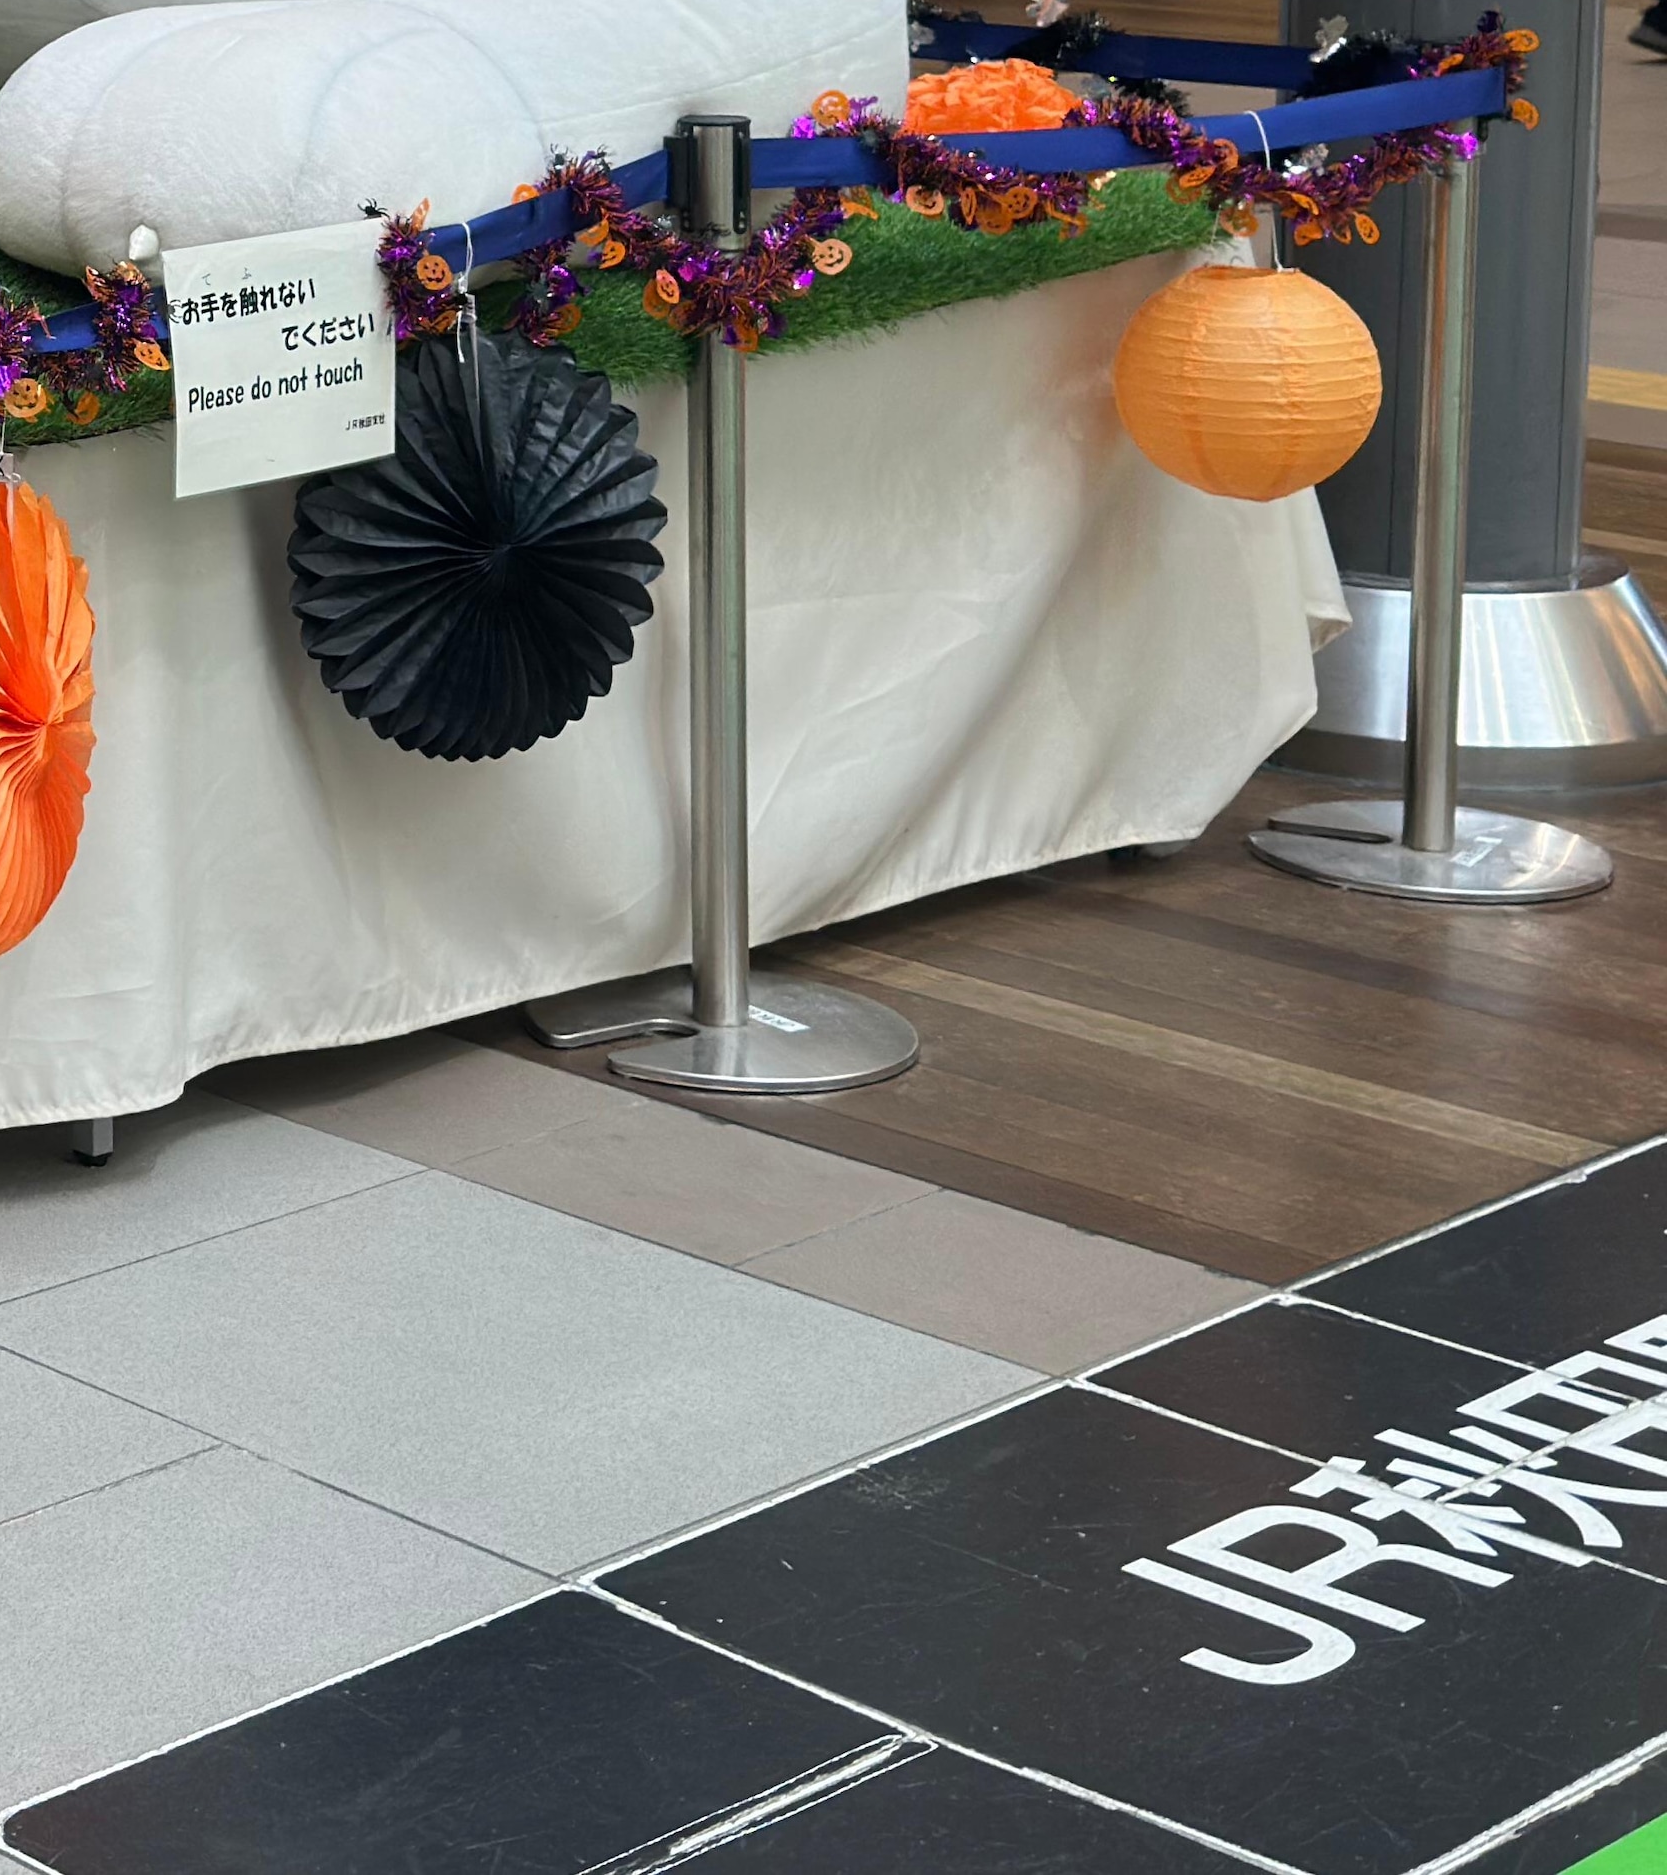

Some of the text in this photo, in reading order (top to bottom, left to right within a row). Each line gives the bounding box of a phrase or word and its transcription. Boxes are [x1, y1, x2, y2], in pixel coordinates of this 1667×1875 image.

[181, 278, 317, 325] お手を触れない
[281, 313, 376, 351] でください
[188, 357, 364, 413] Please do not touch
